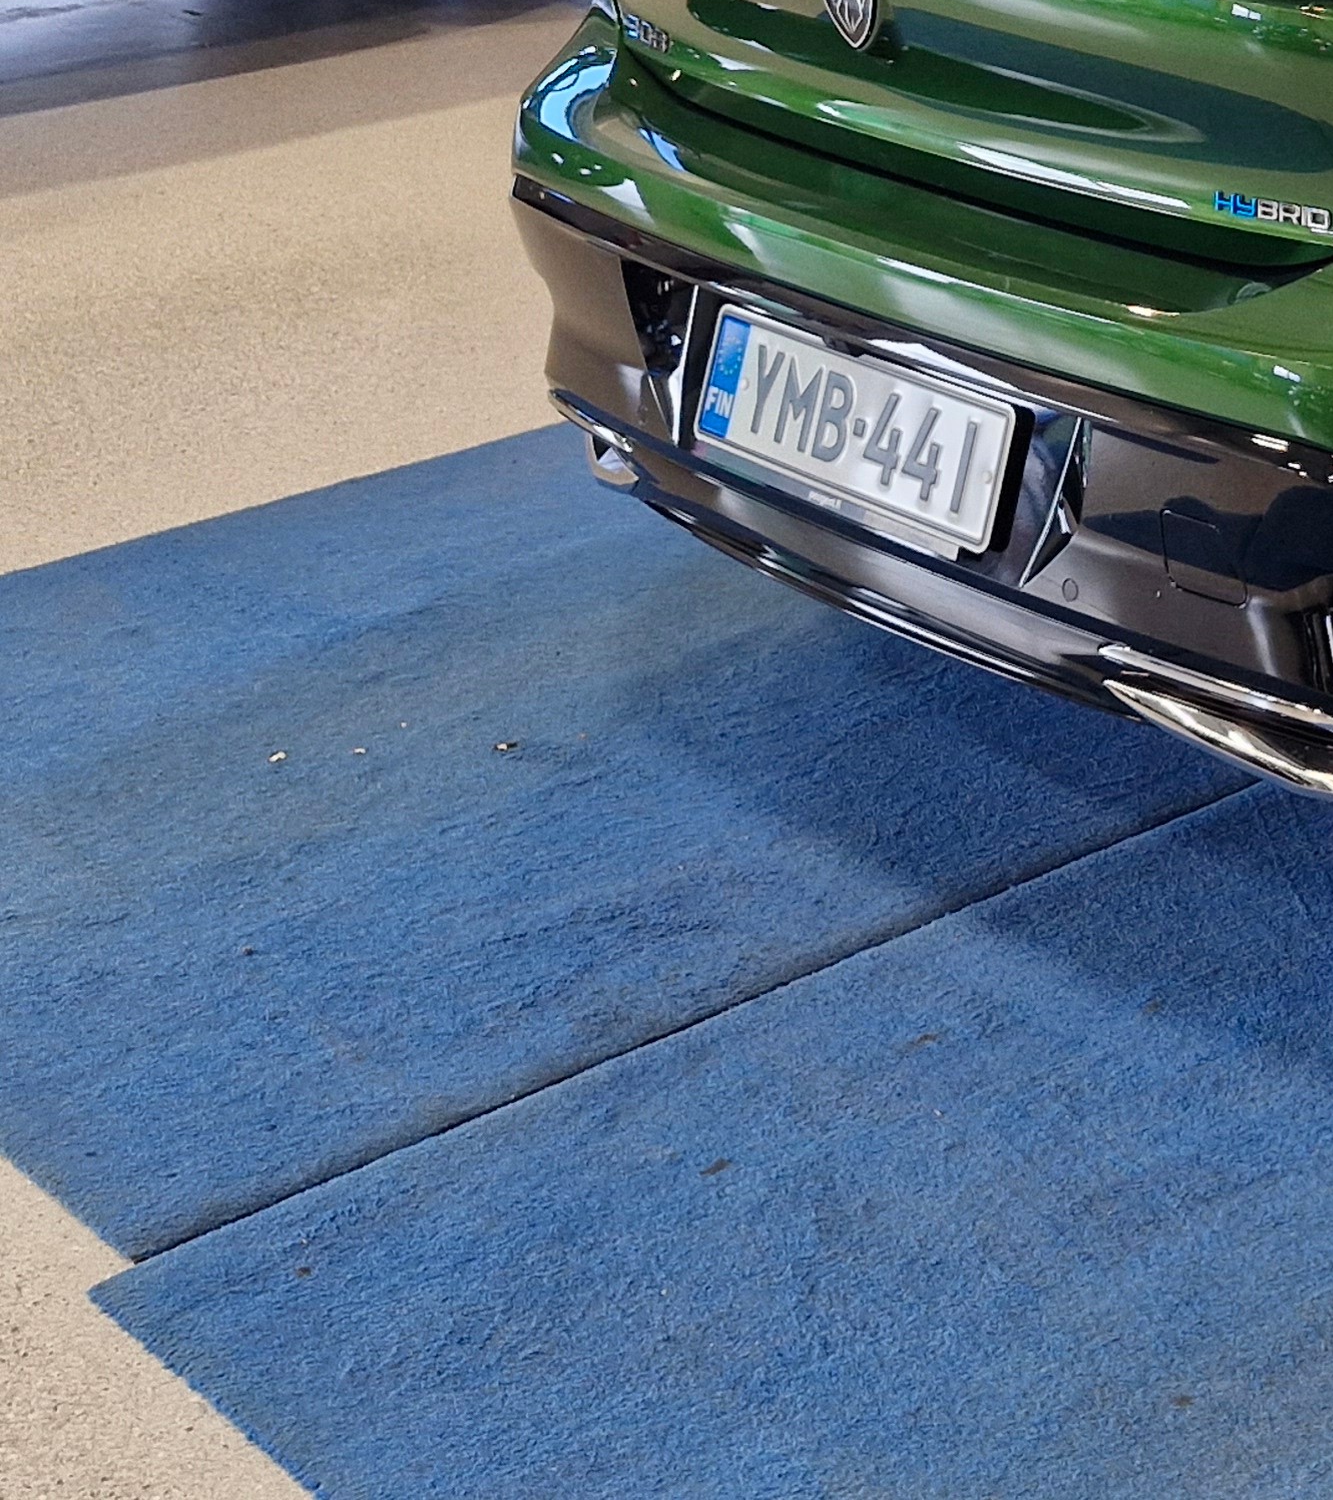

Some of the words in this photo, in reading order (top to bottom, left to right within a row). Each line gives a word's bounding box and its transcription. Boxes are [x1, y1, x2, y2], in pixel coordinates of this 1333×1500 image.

[1213, 190, 1332, 230] HYBRID
[704, 385, 735, 419] FIN
[749, 343, 977, 515] YMB-441
